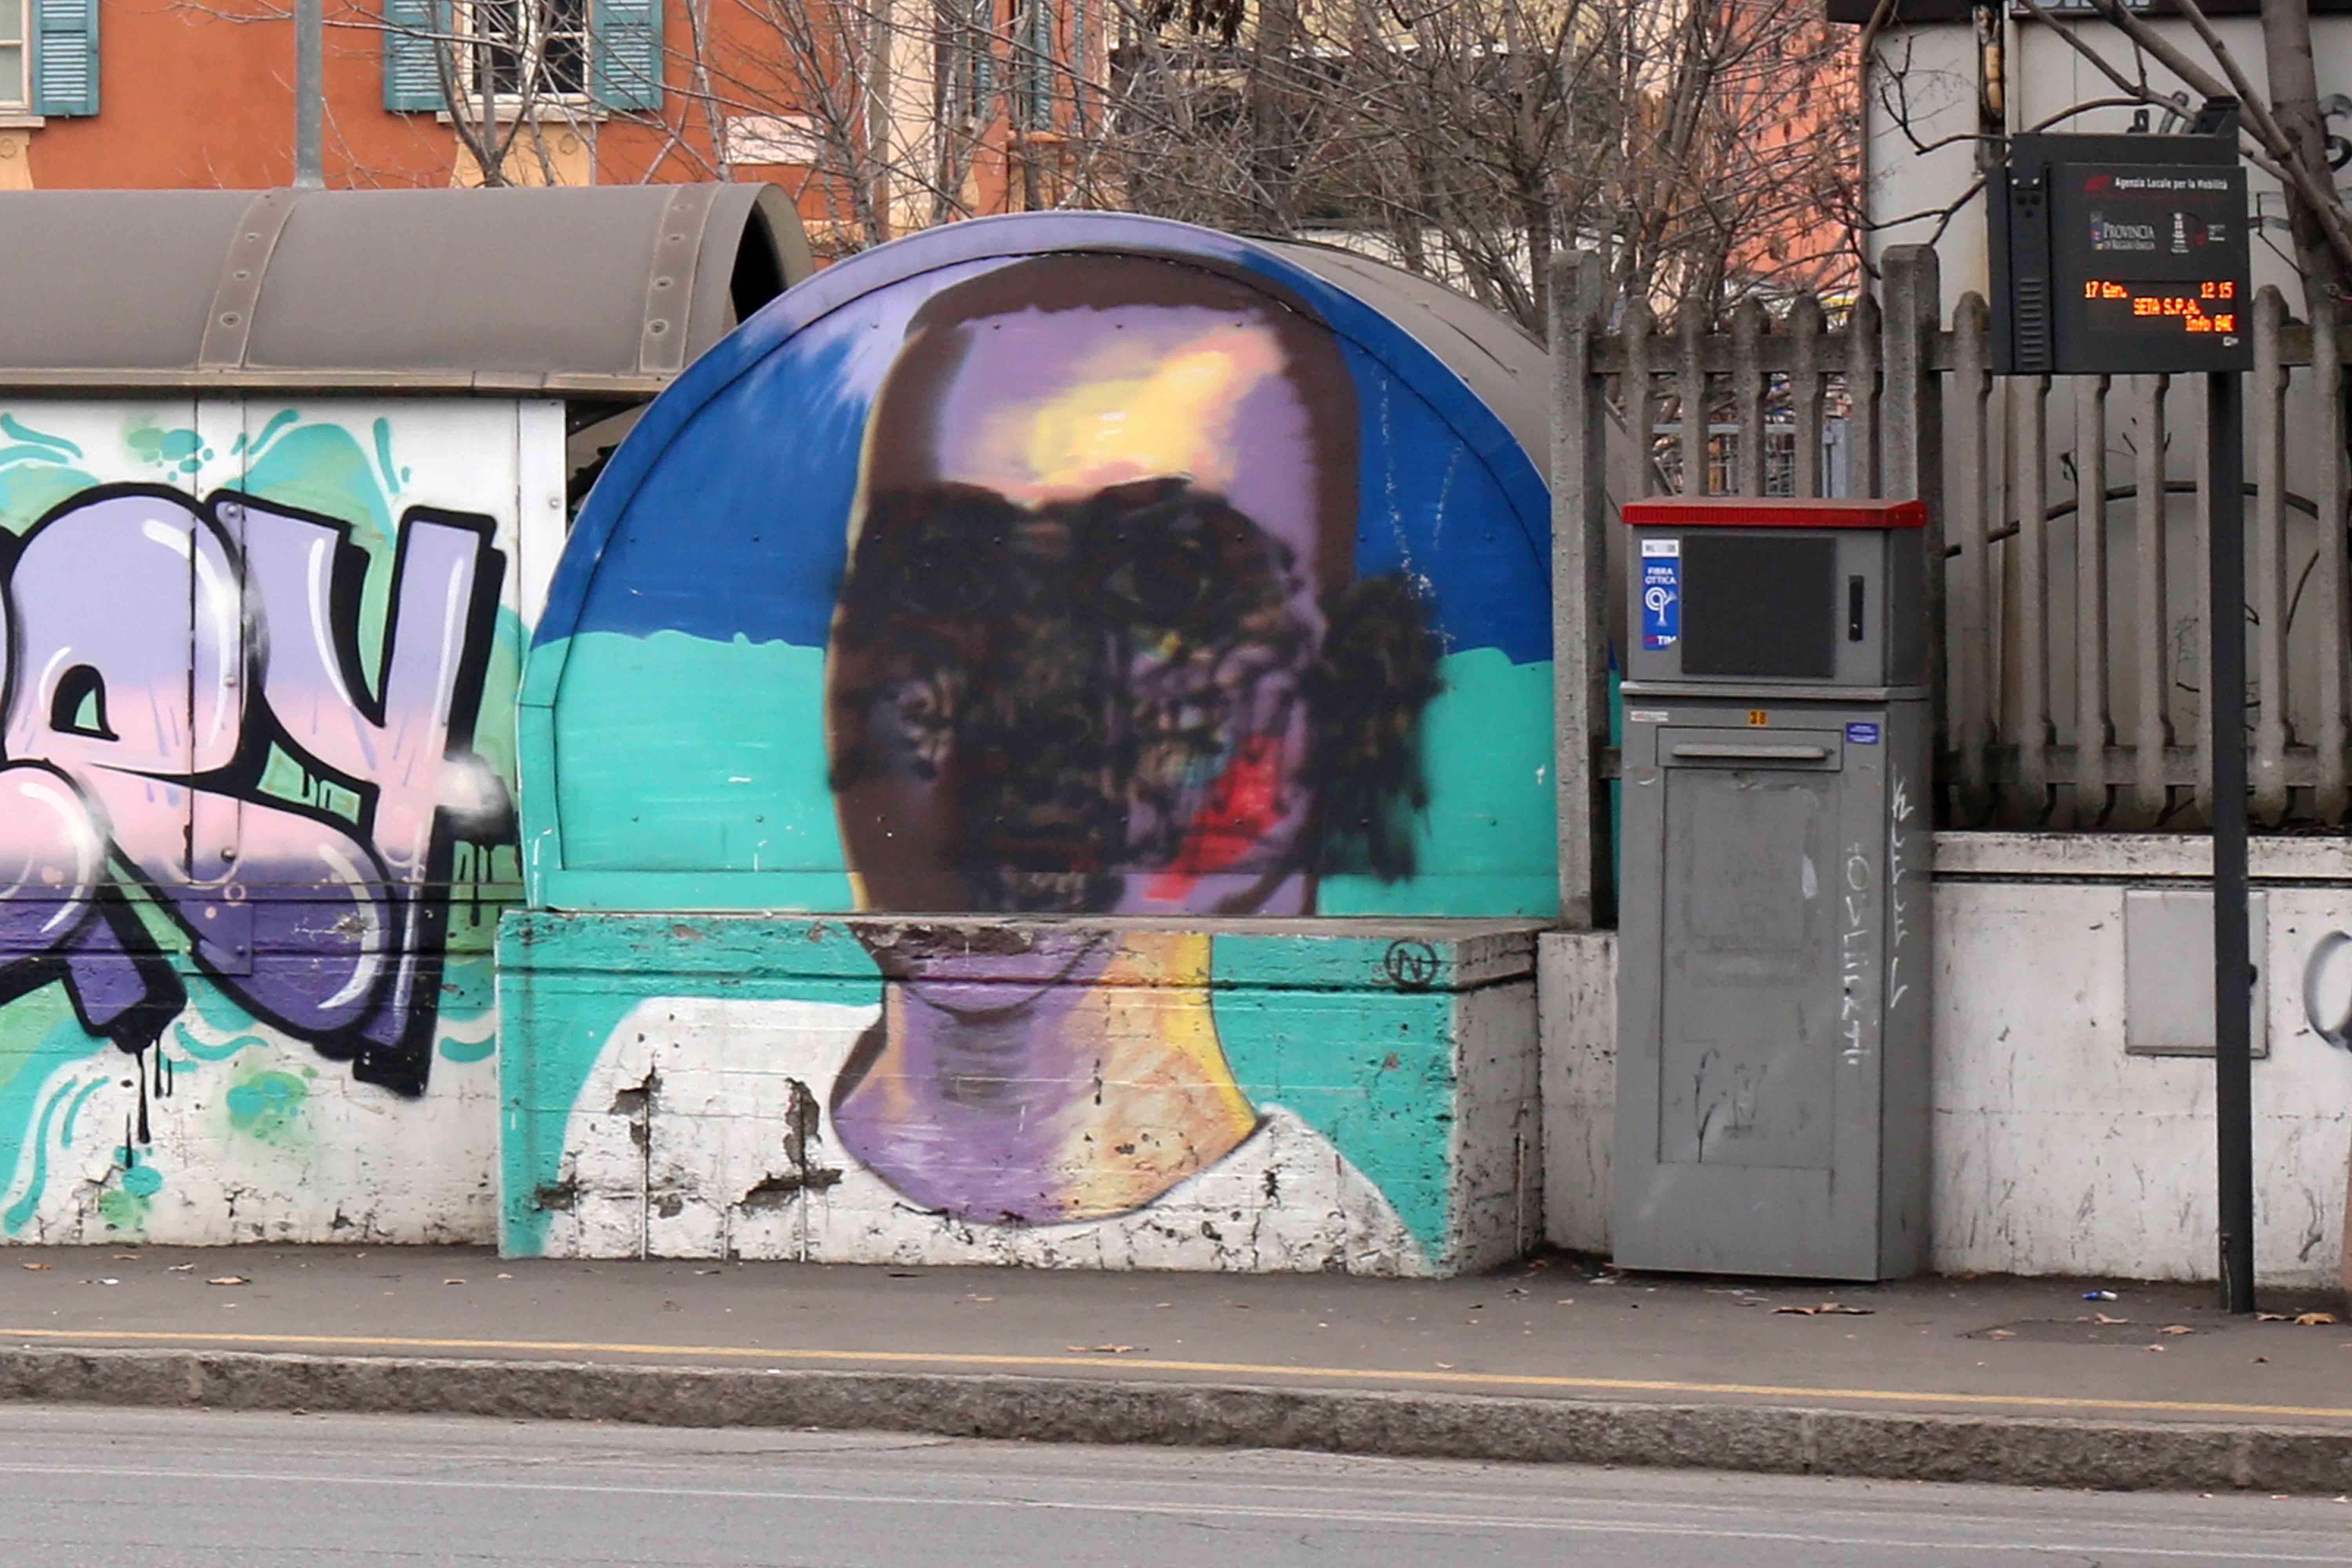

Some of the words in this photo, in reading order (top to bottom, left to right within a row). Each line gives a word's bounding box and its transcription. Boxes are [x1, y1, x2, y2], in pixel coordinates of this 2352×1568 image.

[2115, 177, 2145, 189] Agenzia
[2147, 178, 2171, 189] Locale
[2173, 179, 2185, 190] per
[2188, 178, 2195, 189] la
[2103, 222, 2155, 239] PROVINCIA
[2085, 281, 2099, 298] 17
[2134, 298, 2160, 315] SETA
[1648, 566, 1674, 575] FIBRA
[1645, 575, 1677, 584] OTTICA
